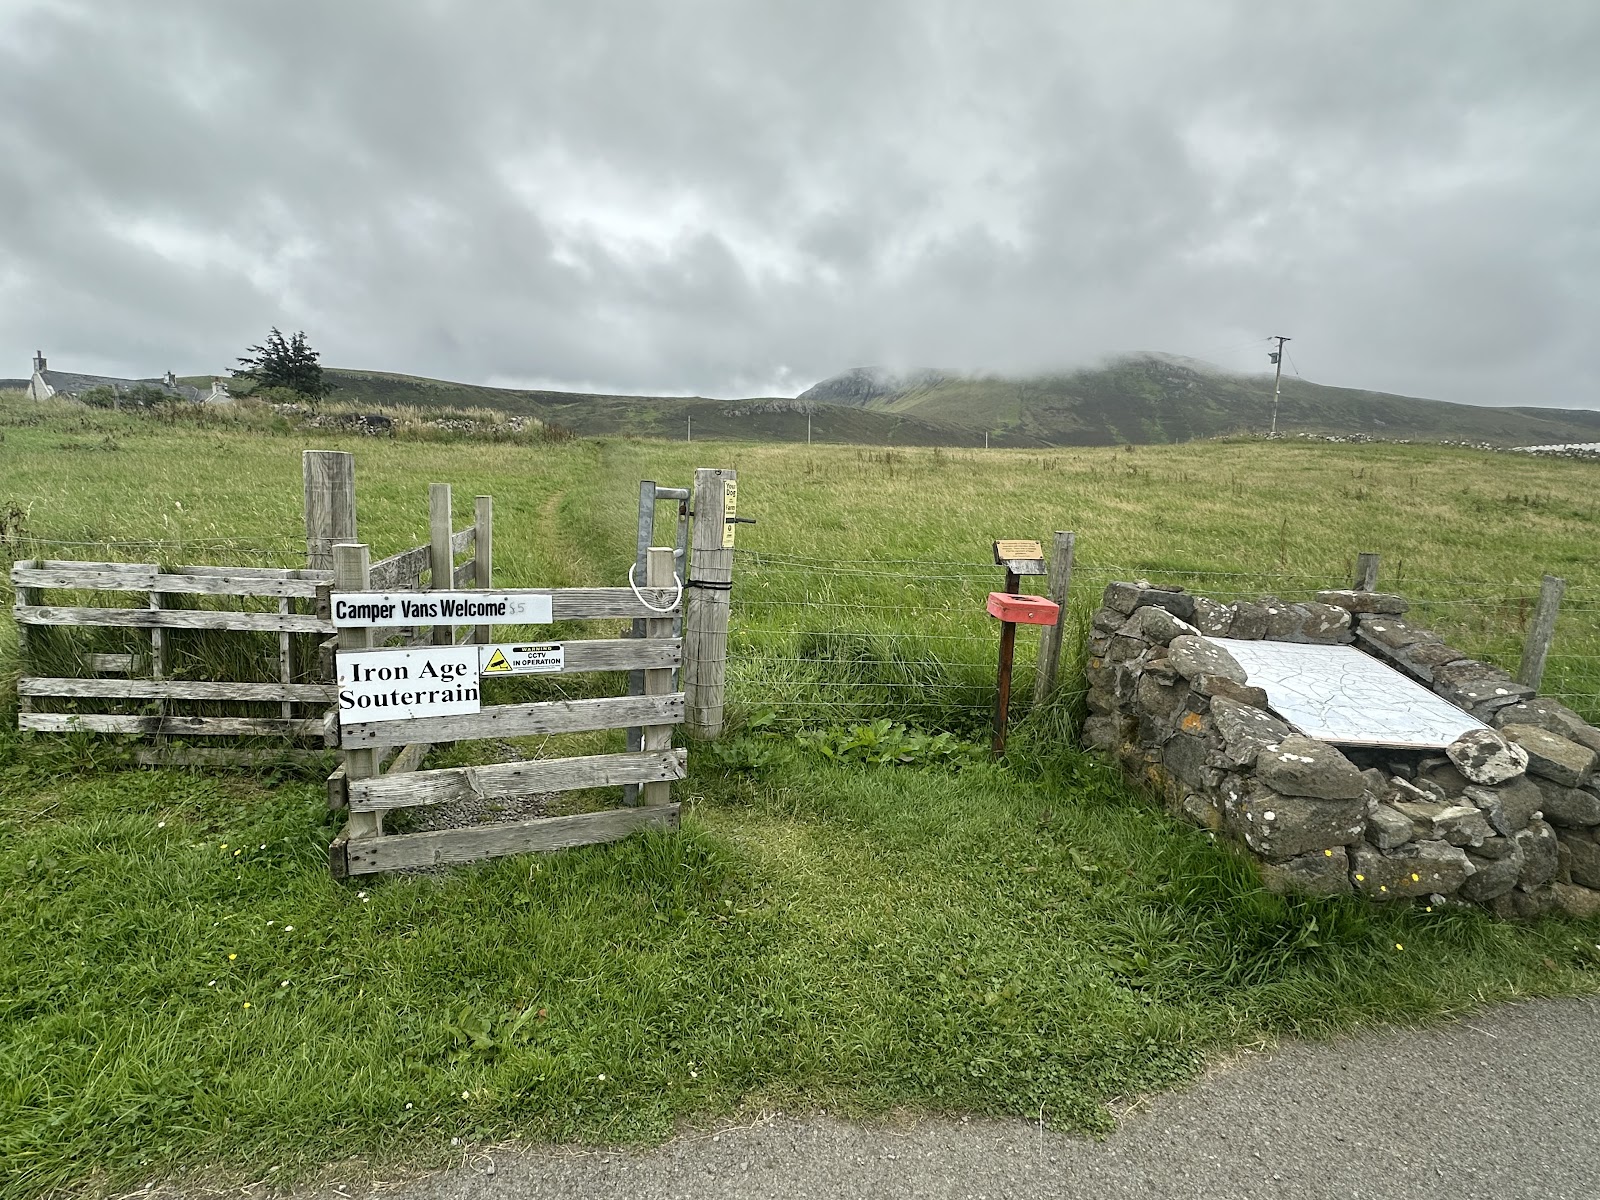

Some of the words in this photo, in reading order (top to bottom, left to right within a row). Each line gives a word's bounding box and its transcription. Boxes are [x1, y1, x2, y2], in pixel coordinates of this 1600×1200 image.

[336, 600, 395, 622] Camper
[401, 600, 438, 617] Vans
[440, 599, 506, 617] Welcome
[351, 663, 409, 682] Iron
[419, 660, 467, 682] Age
[521, 658, 561, 666] OPERATION
[340, 684, 479, 710] Souterrain
